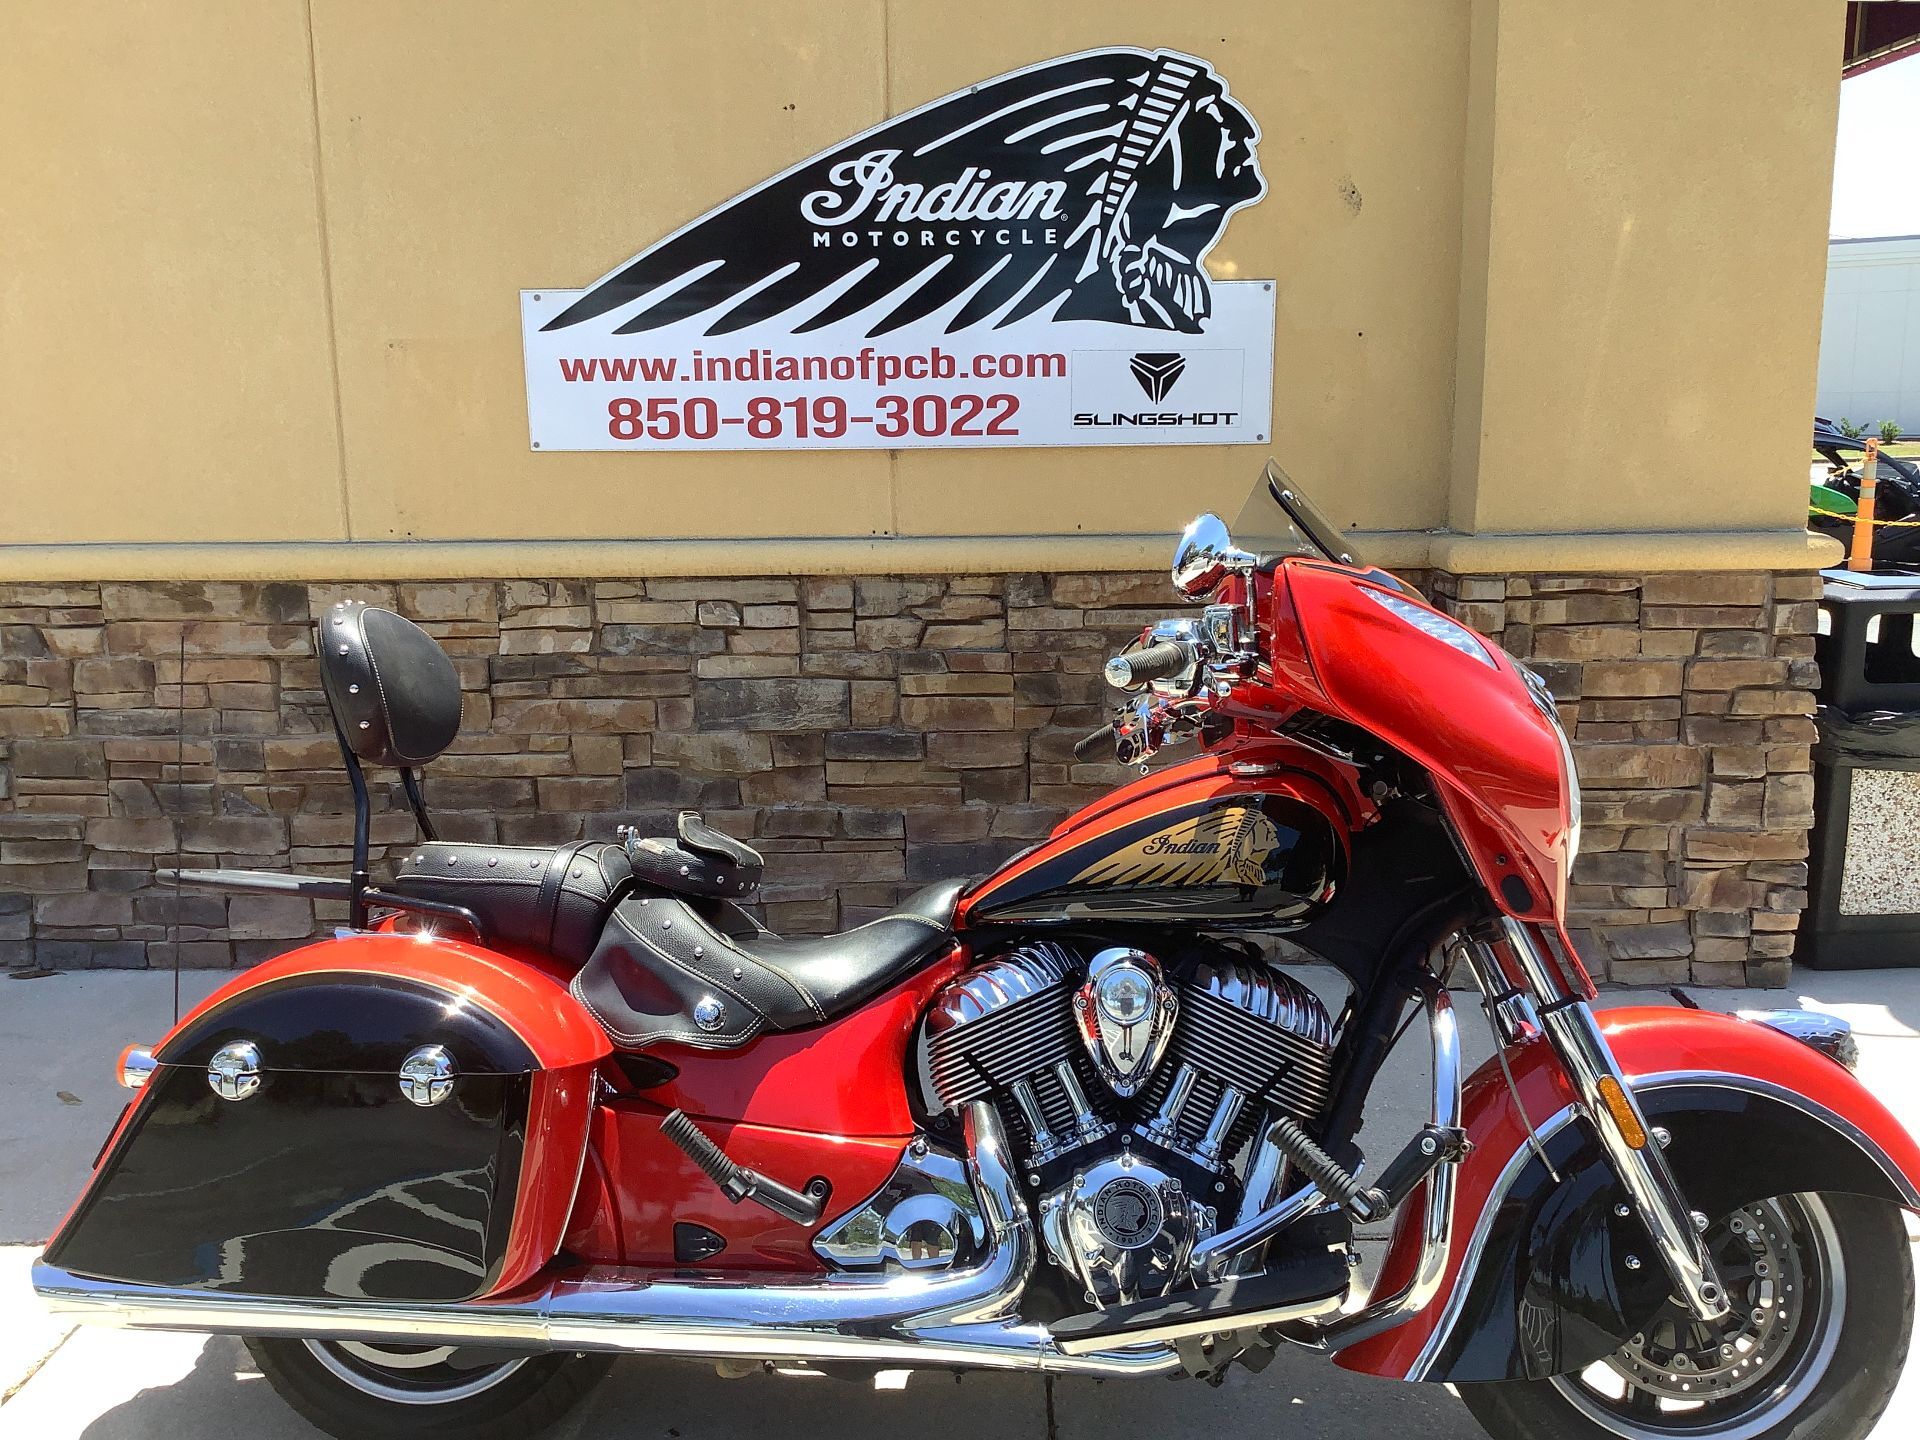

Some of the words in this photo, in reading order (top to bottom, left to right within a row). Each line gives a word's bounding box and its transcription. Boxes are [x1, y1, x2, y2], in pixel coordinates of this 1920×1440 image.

[800, 149, 1067, 226] Indian
[813, 229, 1057, 247] MOTORCYCLE
[559, 347, 1067, 386] www.indianofpcb.com
[608, 394, 1021, 441] 850-819-3022
[1073, 413, 1239, 425] SLINGSHOT
[1142, 834, 1221, 855] Indian
[1098, 1189, 1112, 1230] INDIAN
[1115, 1181, 1158, 1232] MOTORCYCLE
